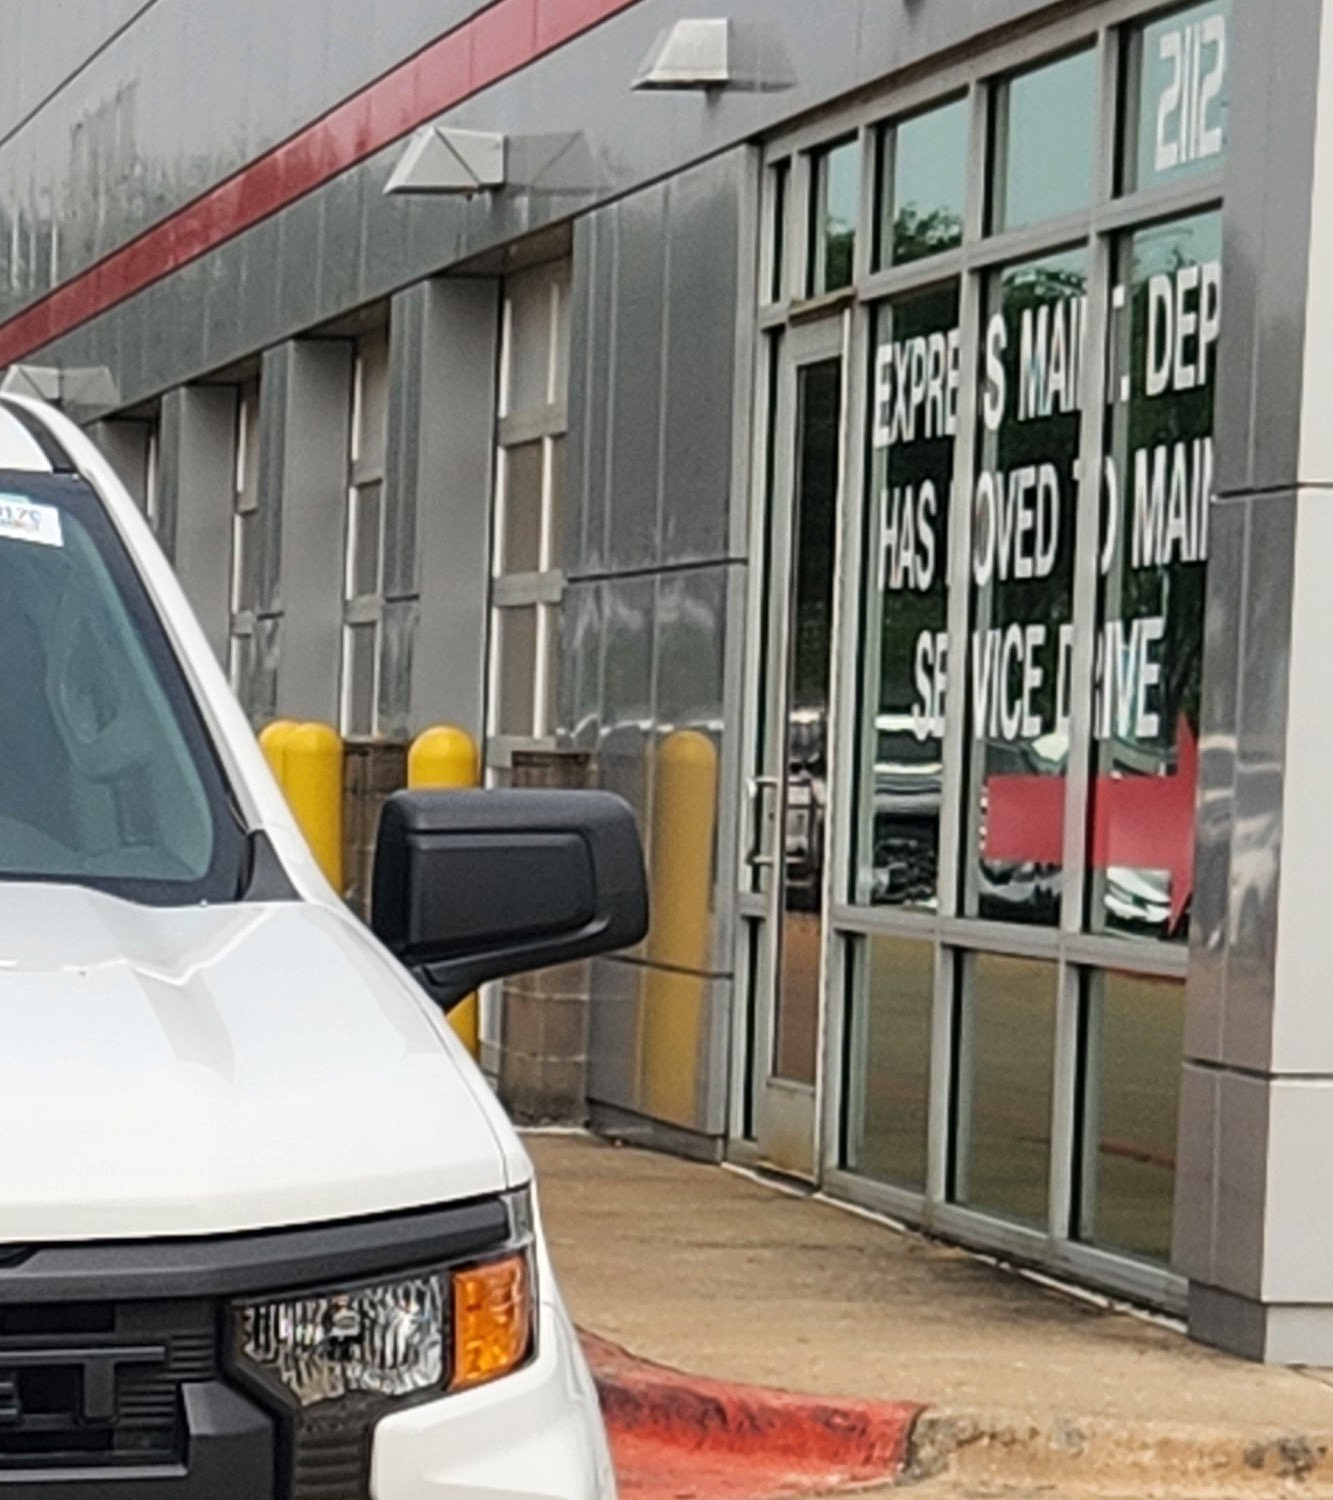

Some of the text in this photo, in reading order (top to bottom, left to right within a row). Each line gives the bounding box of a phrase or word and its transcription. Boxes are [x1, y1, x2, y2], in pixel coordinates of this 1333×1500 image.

[1155, 15, 1225, 171] 2112
[873, 311, 1008, 449] EXPRES
[878, 479, 936, 592] HAS
[947, 463, 1060, 587] OVED
[911, 622, 1046, 741] SEVICE
